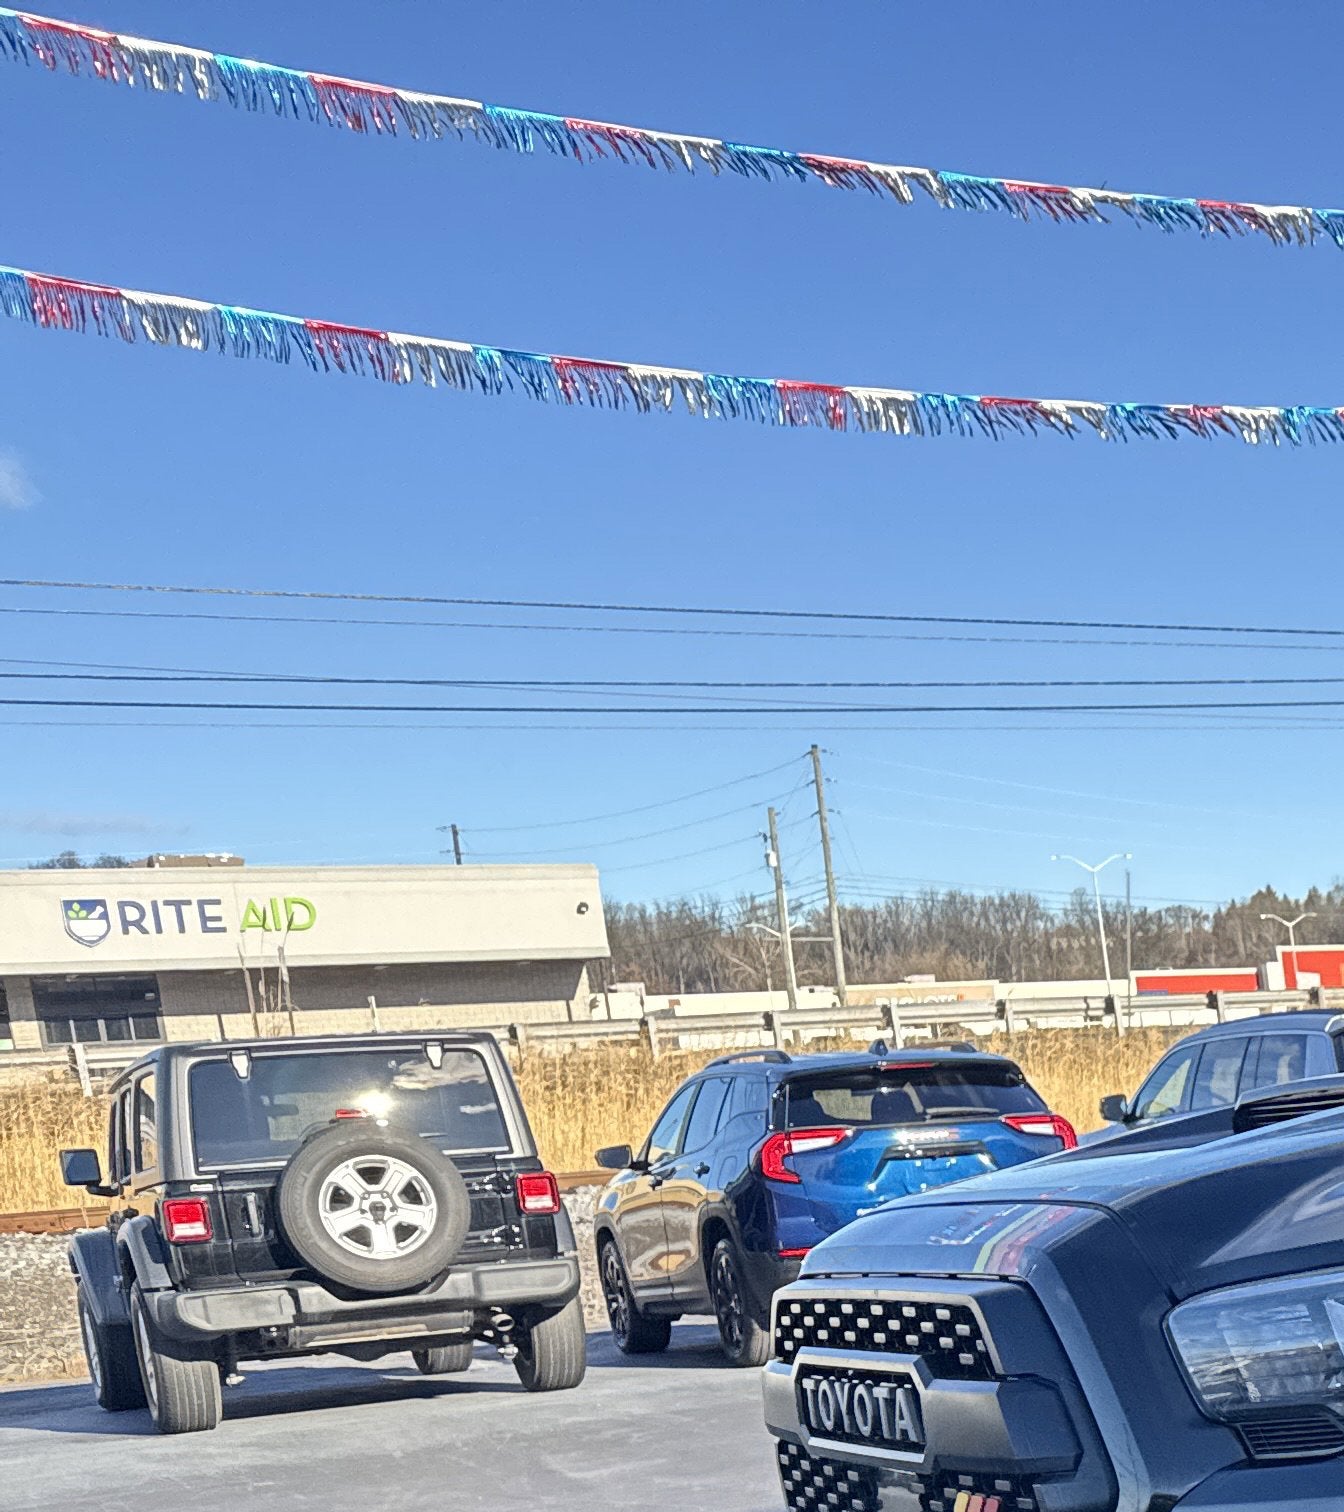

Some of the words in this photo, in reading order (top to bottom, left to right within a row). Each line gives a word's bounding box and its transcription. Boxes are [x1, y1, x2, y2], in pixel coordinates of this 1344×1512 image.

[117, 899, 227, 935] RITE
[240, 898, 317, 933] AID
[802, 1377, 920, 1443] TOYOTA
